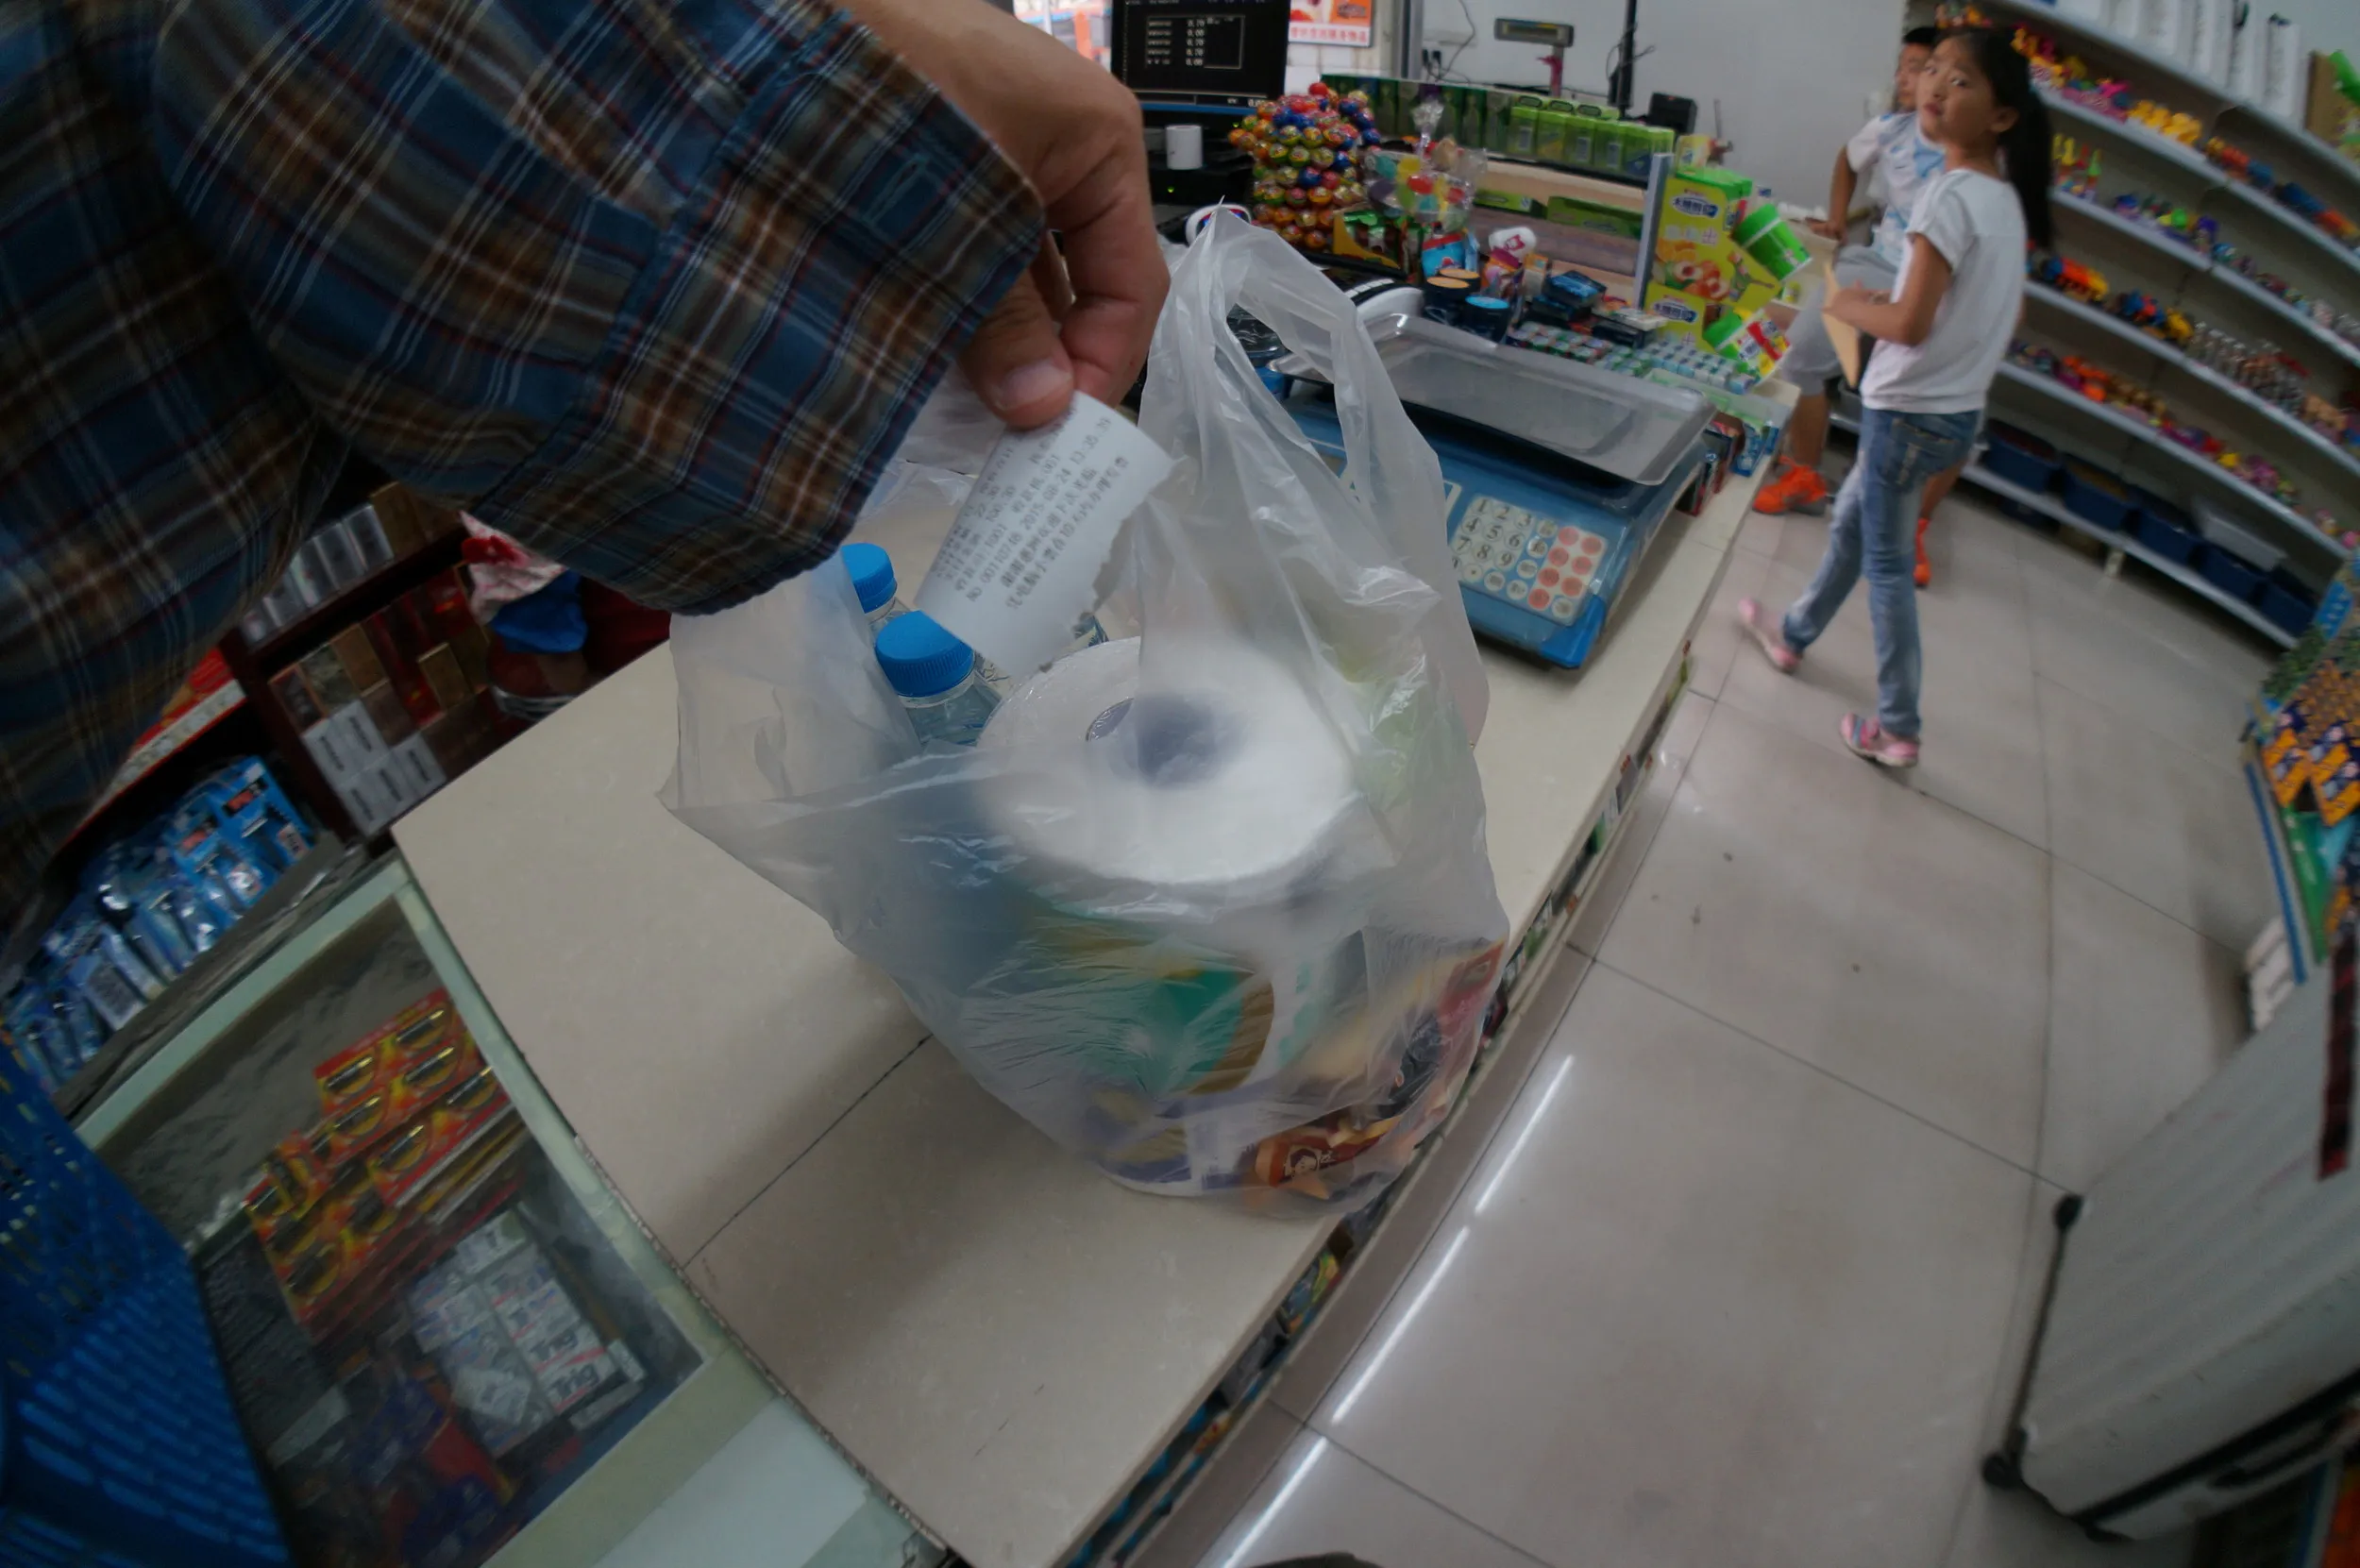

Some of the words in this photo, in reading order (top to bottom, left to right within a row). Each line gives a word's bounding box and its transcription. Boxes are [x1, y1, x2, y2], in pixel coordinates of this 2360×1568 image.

[1477, 498, 1487, 514] 1
[1497, 506, 1510, 520] 2
[1518, 514, 1532, 528] 3
[1466, 516, 1480, 532] 4
[1487, 525, 1503, 539] 5
[1509, 533, 1522, 548] 6
[1458, 536, 1472, 551] 7
[1476, 544, 1492, 560] 8
[1501, 553, 1514, 566] 9
